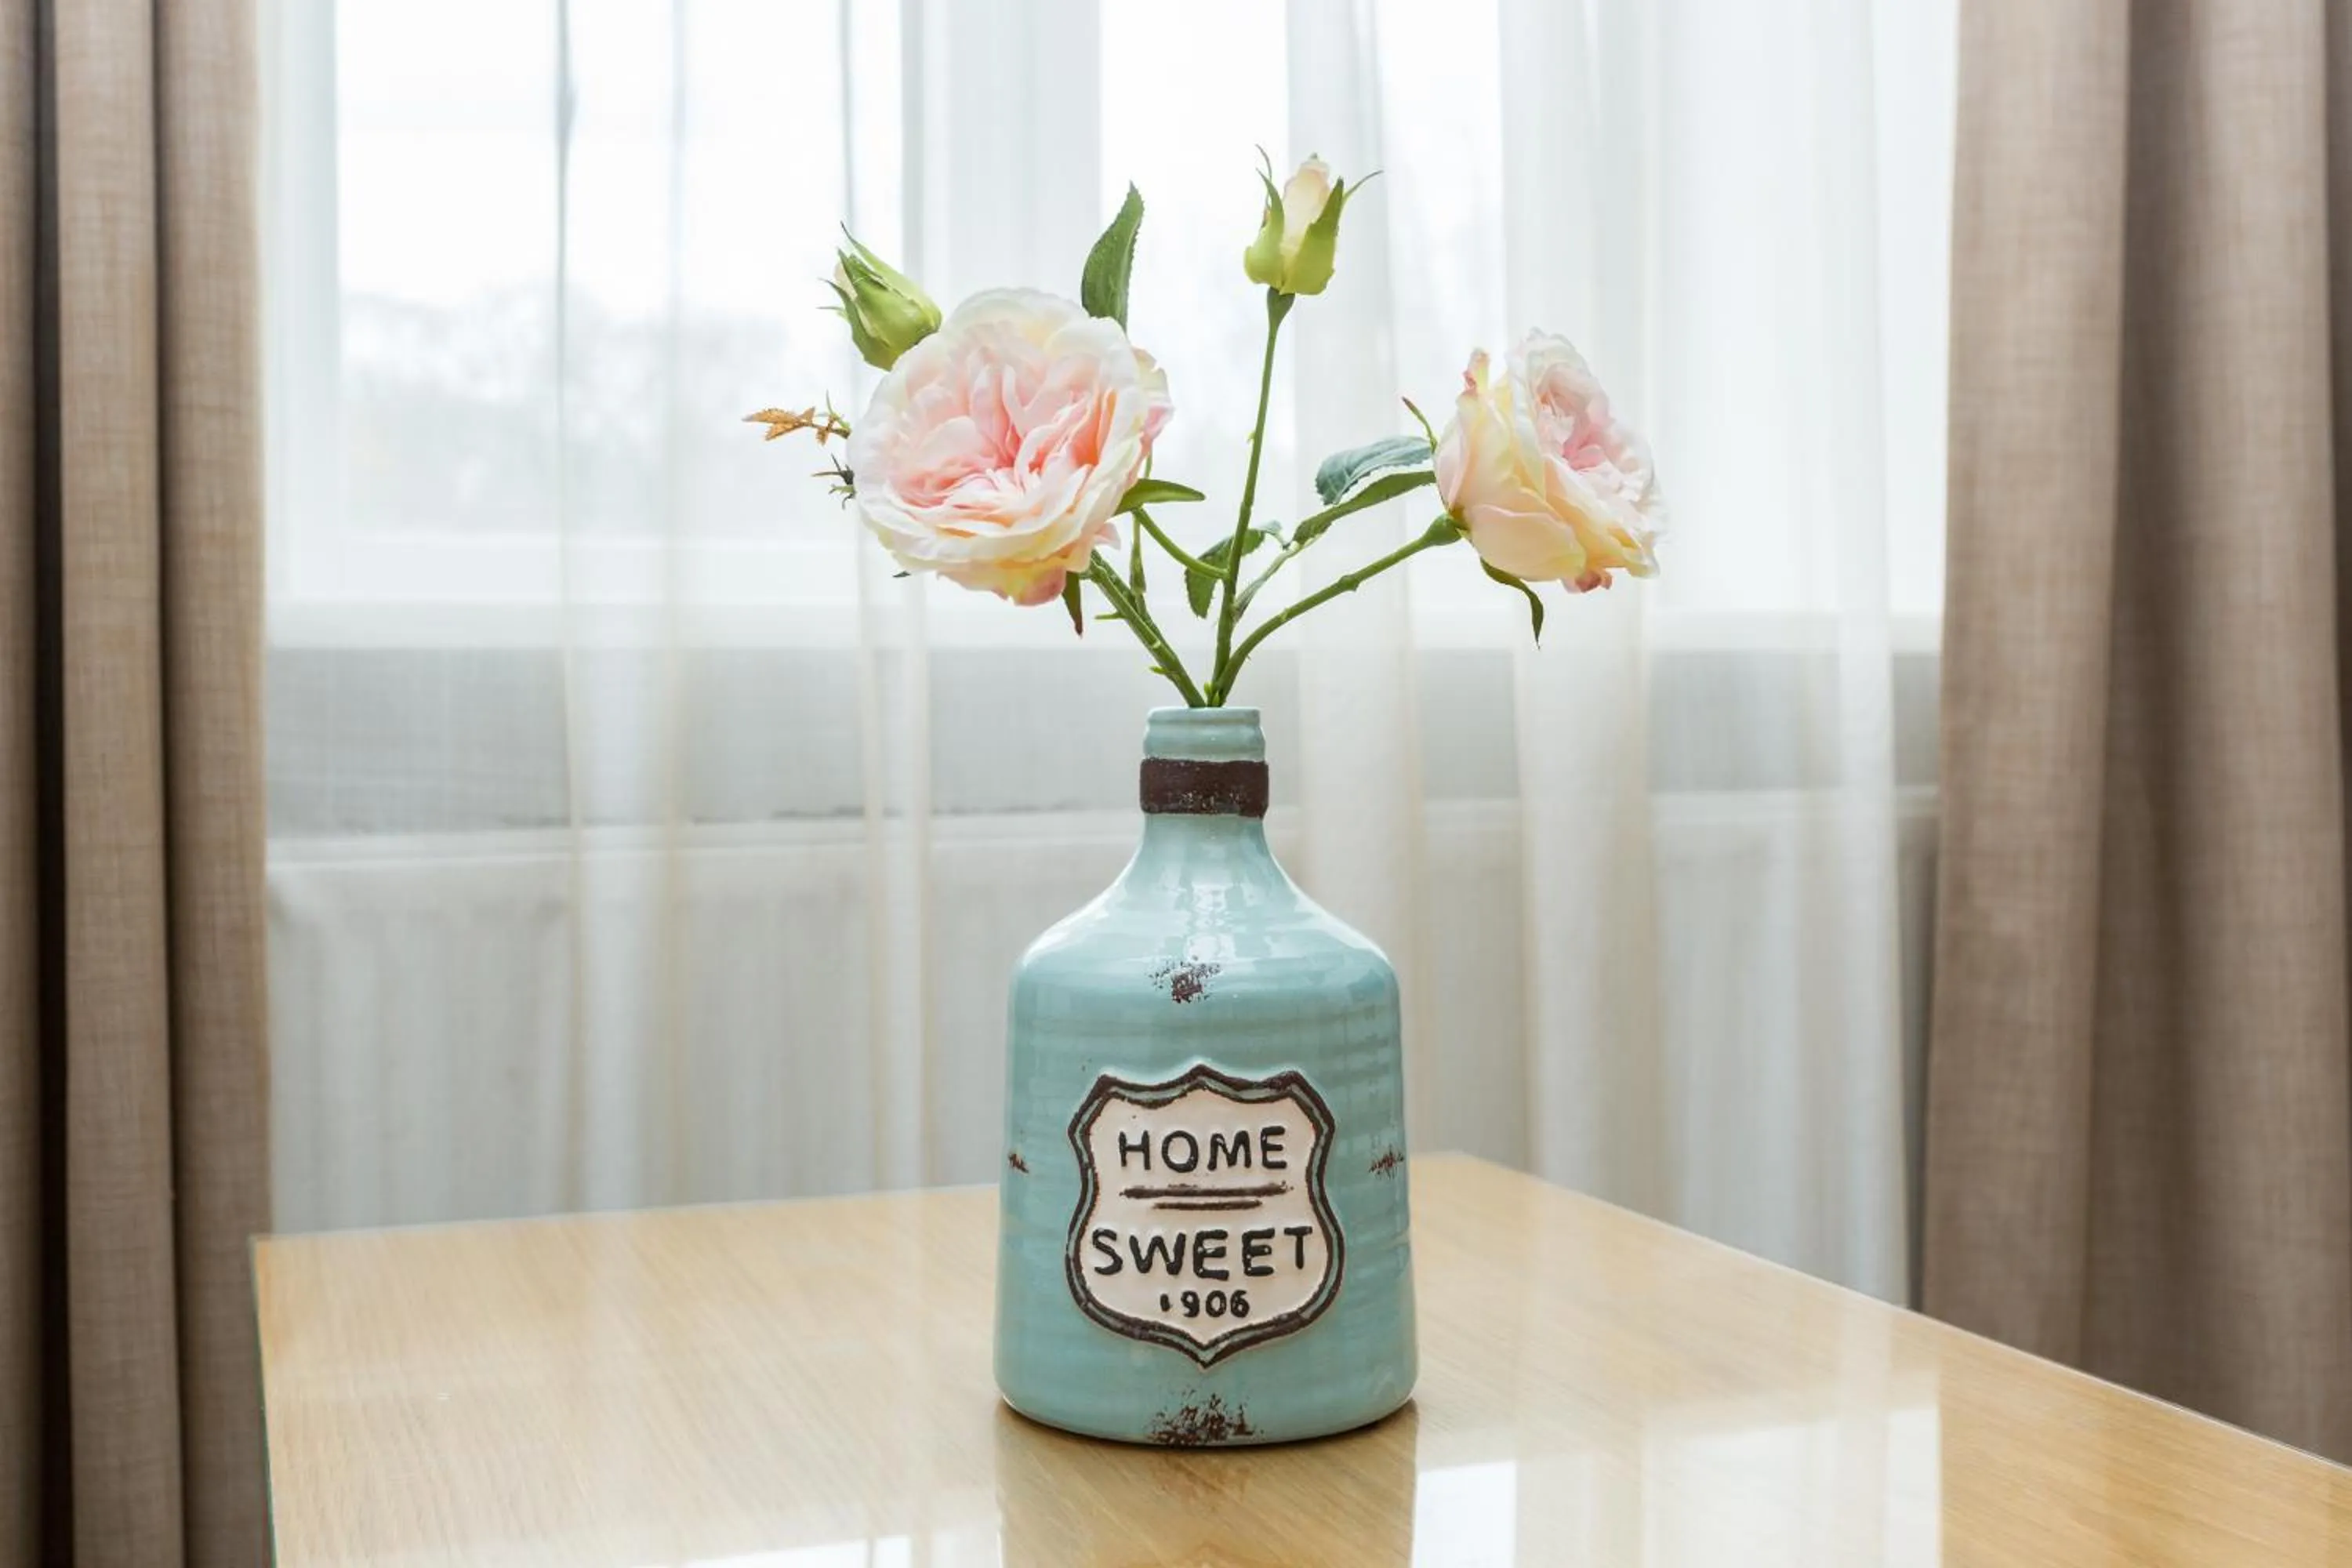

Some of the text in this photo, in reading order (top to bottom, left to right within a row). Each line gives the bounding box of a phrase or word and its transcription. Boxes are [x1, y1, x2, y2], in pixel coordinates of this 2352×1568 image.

[1118, 1125, 1288, 1174] HOME
[1091, 1225, 1314, 1282] SWEET
[1159, 1289, 1251, 1319] 1906
